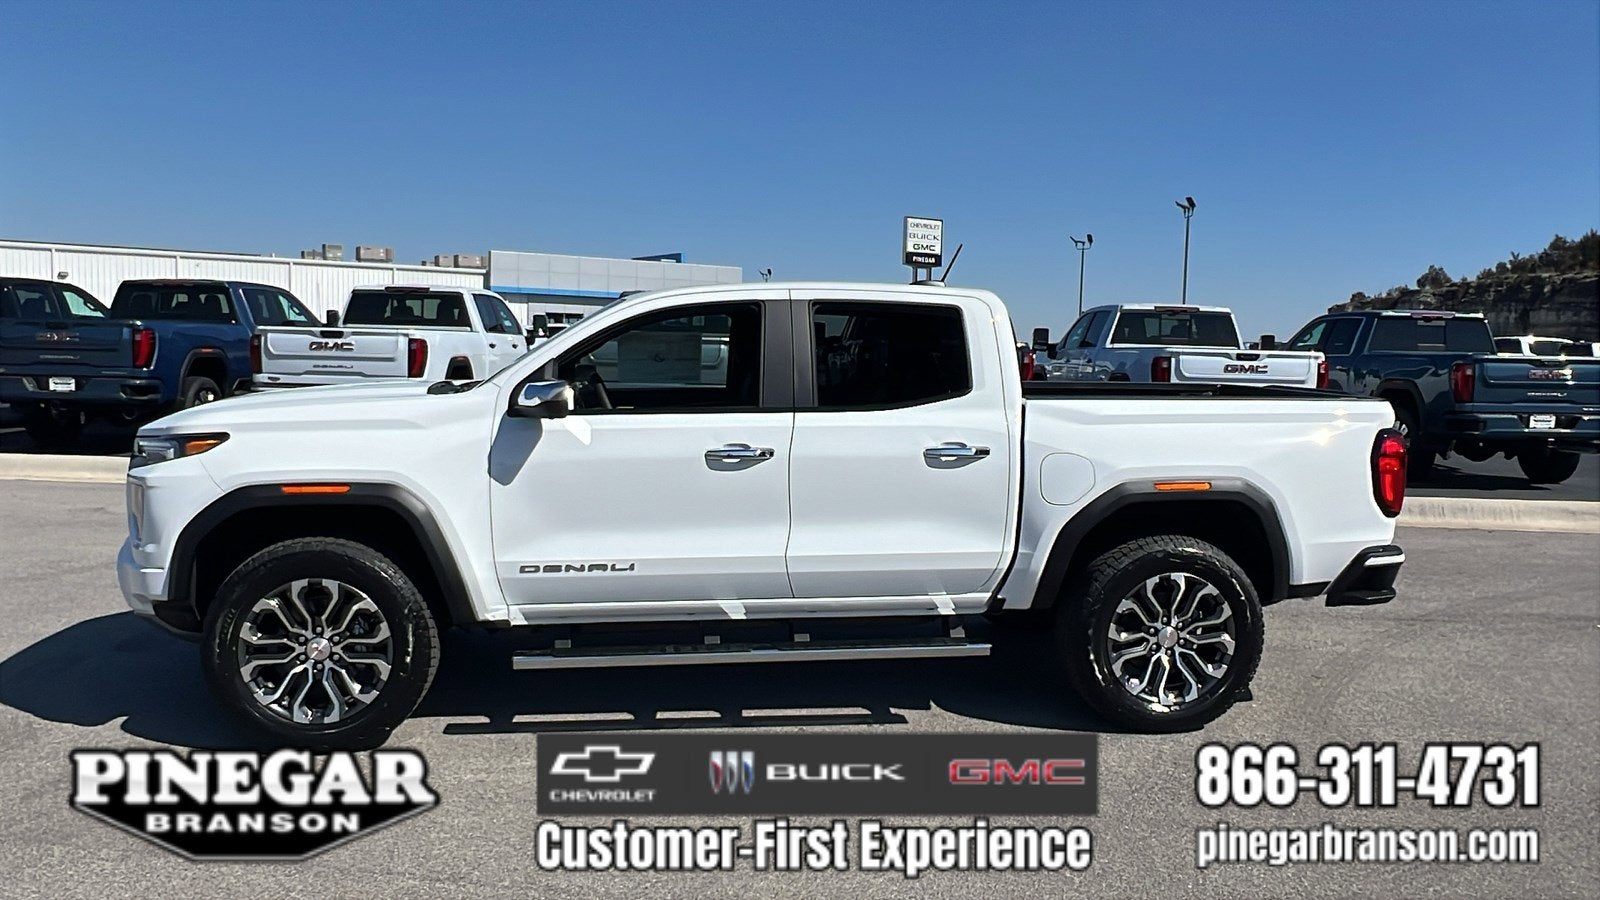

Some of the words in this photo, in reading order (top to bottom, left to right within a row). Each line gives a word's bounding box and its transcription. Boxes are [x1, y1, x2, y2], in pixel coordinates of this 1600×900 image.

[909, 233, 940, 241] BUICK
[913, 243, 936, 252] GMC
[309, 341, 354, 352] GMC
[1223, 364, 1268, 374] GMC
[519, 563, 635, 574] DENALI
